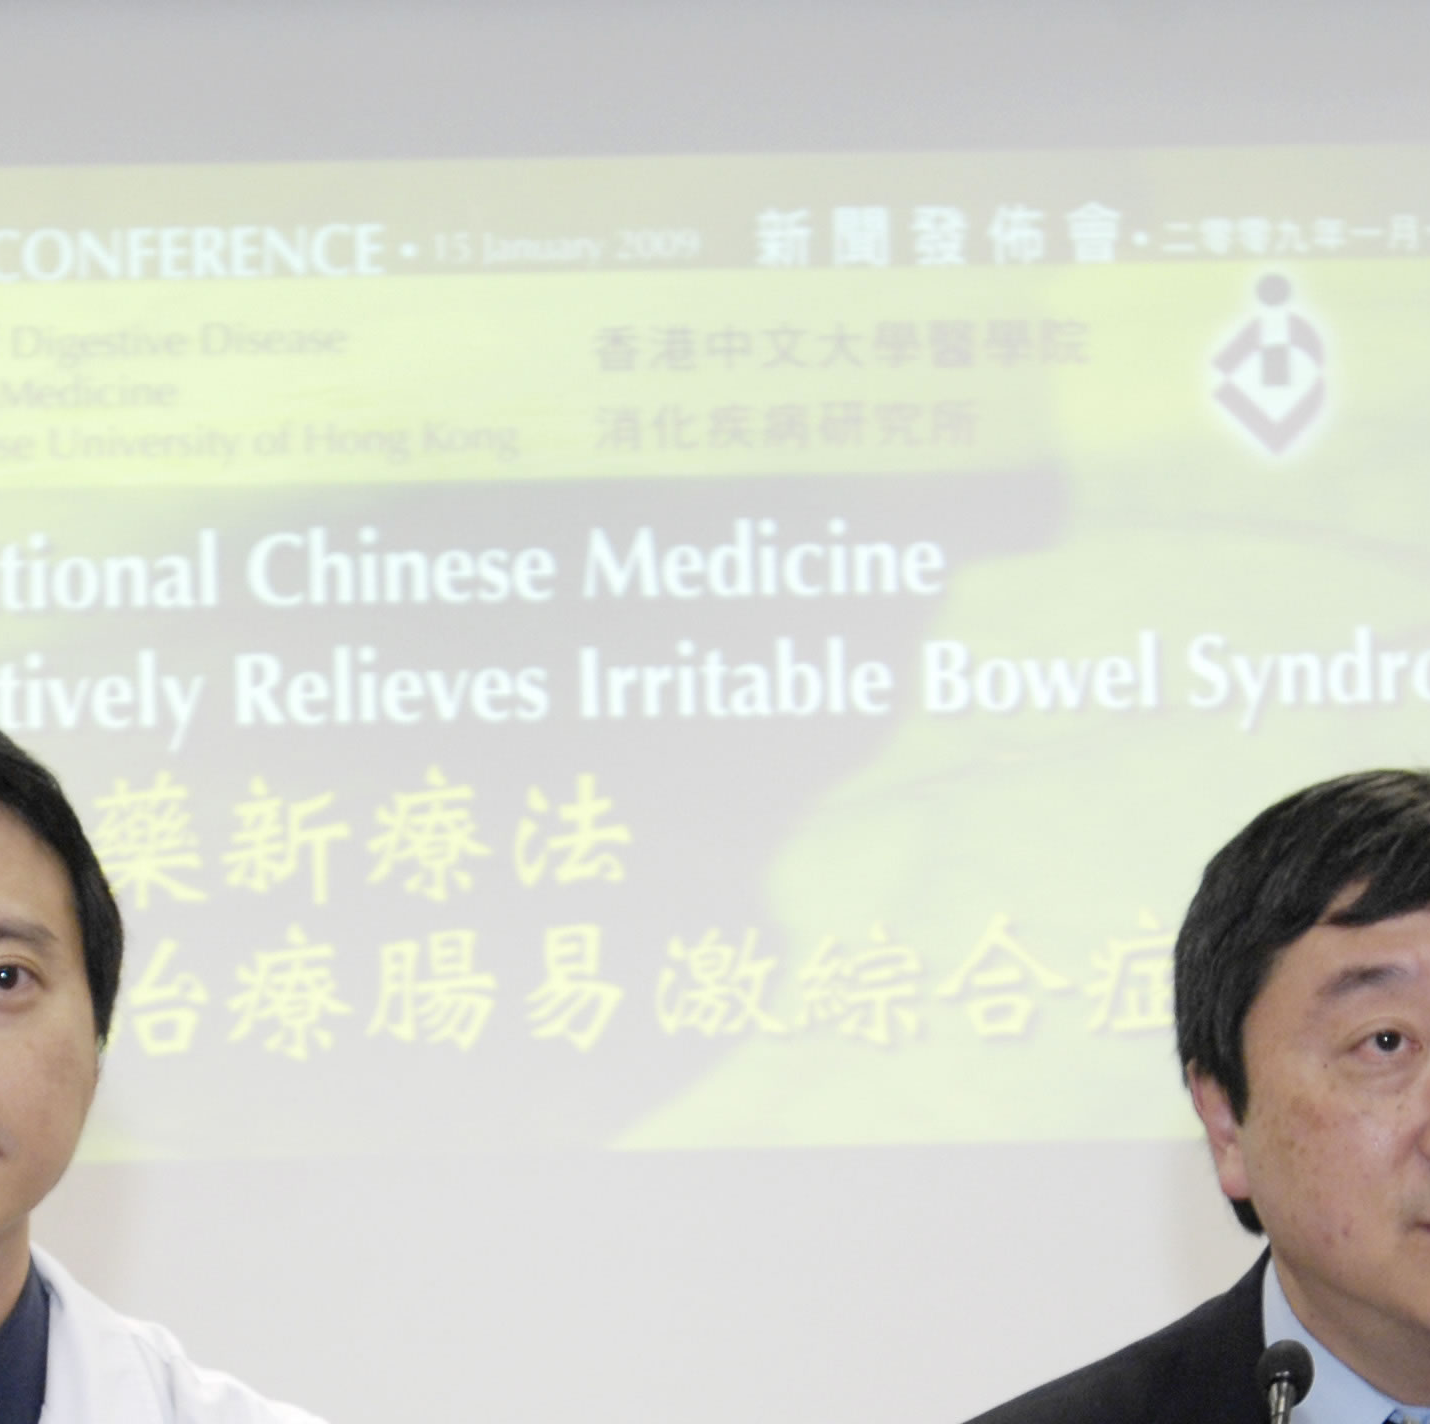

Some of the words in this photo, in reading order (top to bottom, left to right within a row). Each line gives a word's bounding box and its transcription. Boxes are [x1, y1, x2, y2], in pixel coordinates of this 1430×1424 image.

[435, 231, 470, 263] 15
[483, 231, 603, 266] January
[616, 227, 700, 261] 2009
[9, 322, 188, 369] Digestive
[198, 320, 350, 357] Disease
[593, 318, 1092, 372] 香港中文大學醫學院
[47, 424, 239, 468] University
[252, 420, 292, 457] of
[304, 420, 411, 464] Hong
[421, 420, 521, 463] Kong
[593, 400, 982, 451] 消化疾病研究所
[245, 525, 556, 607] Chinese
[580, 518, 946, 598] Medicine
[233, 644, 549, 727] Relieves
[579, 636, 893, 720] Irritable
[922, 629, 1160, 714] Bowel
